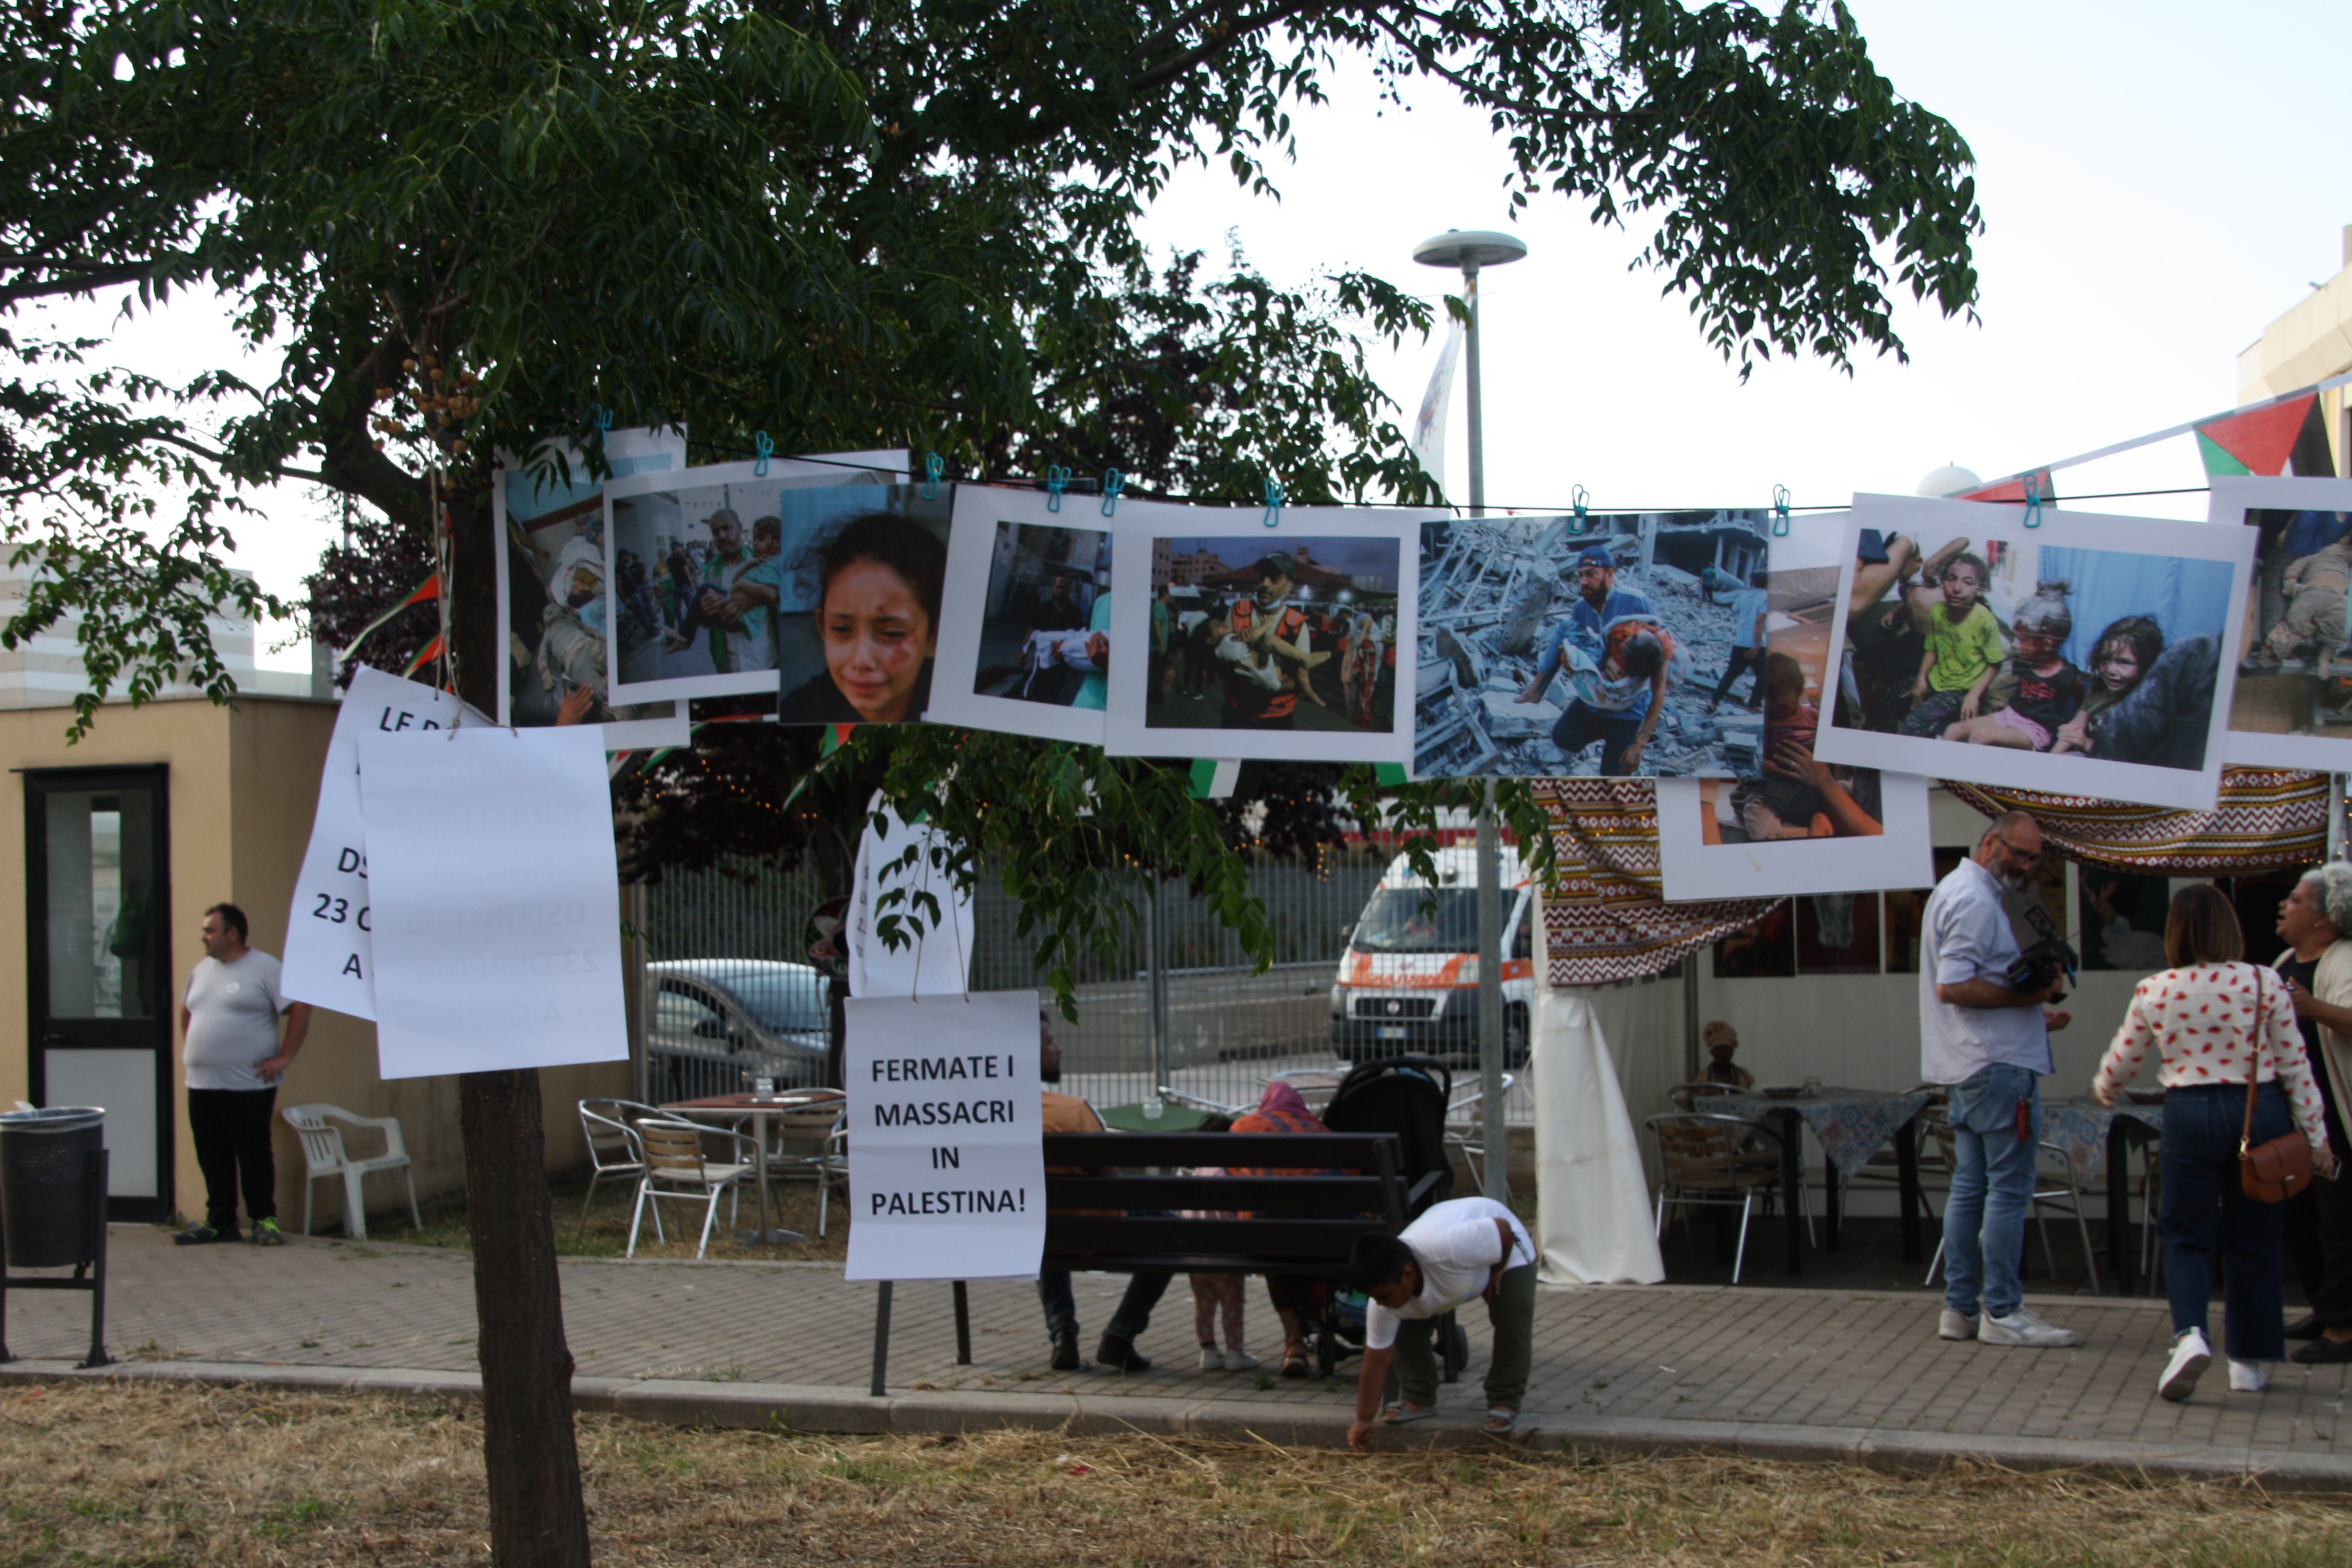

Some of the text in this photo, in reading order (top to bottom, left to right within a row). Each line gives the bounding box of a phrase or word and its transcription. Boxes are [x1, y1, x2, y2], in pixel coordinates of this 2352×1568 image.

[313, 893, 349, 924] 23
[342, 953, 362, 979] A
[872, 1055, 1014, 1082] FERMATE I
[874, 1100, 1014, 1126] MASSACRI
[932, 1147, 960, 1169] IN
[872, 1188, 1026, 1215] PALESTINA!
